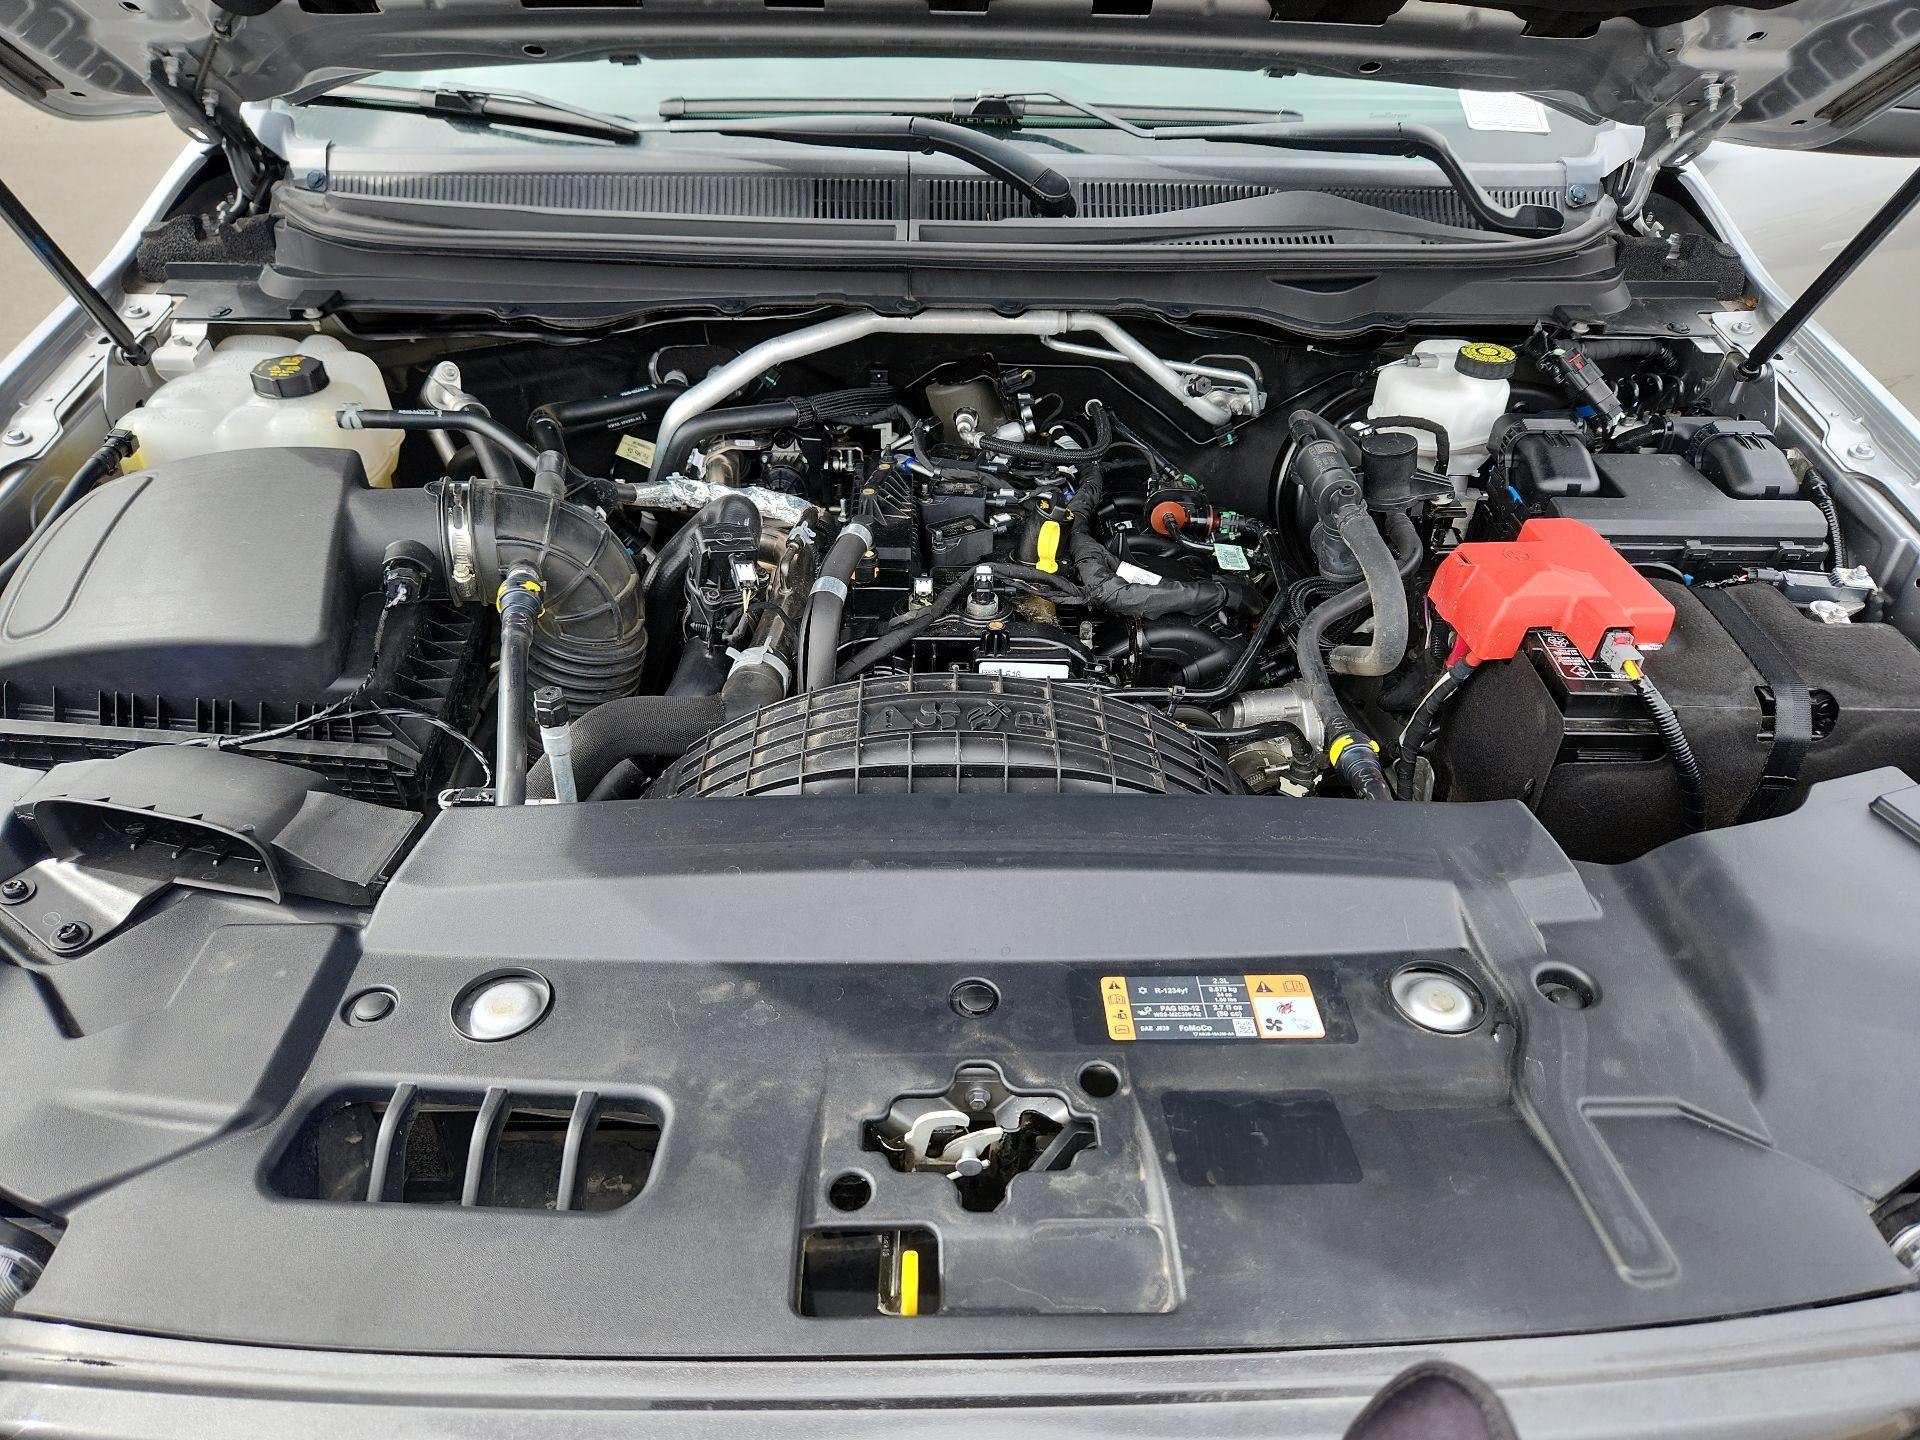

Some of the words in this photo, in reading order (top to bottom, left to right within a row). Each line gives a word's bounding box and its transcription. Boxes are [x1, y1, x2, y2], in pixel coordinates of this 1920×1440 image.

[1154, 987, 1188, 995] R-1234yf
[1227, 986, 1238, 994] kg
[1179, 1024, 1213, 1032] FoMoCo
